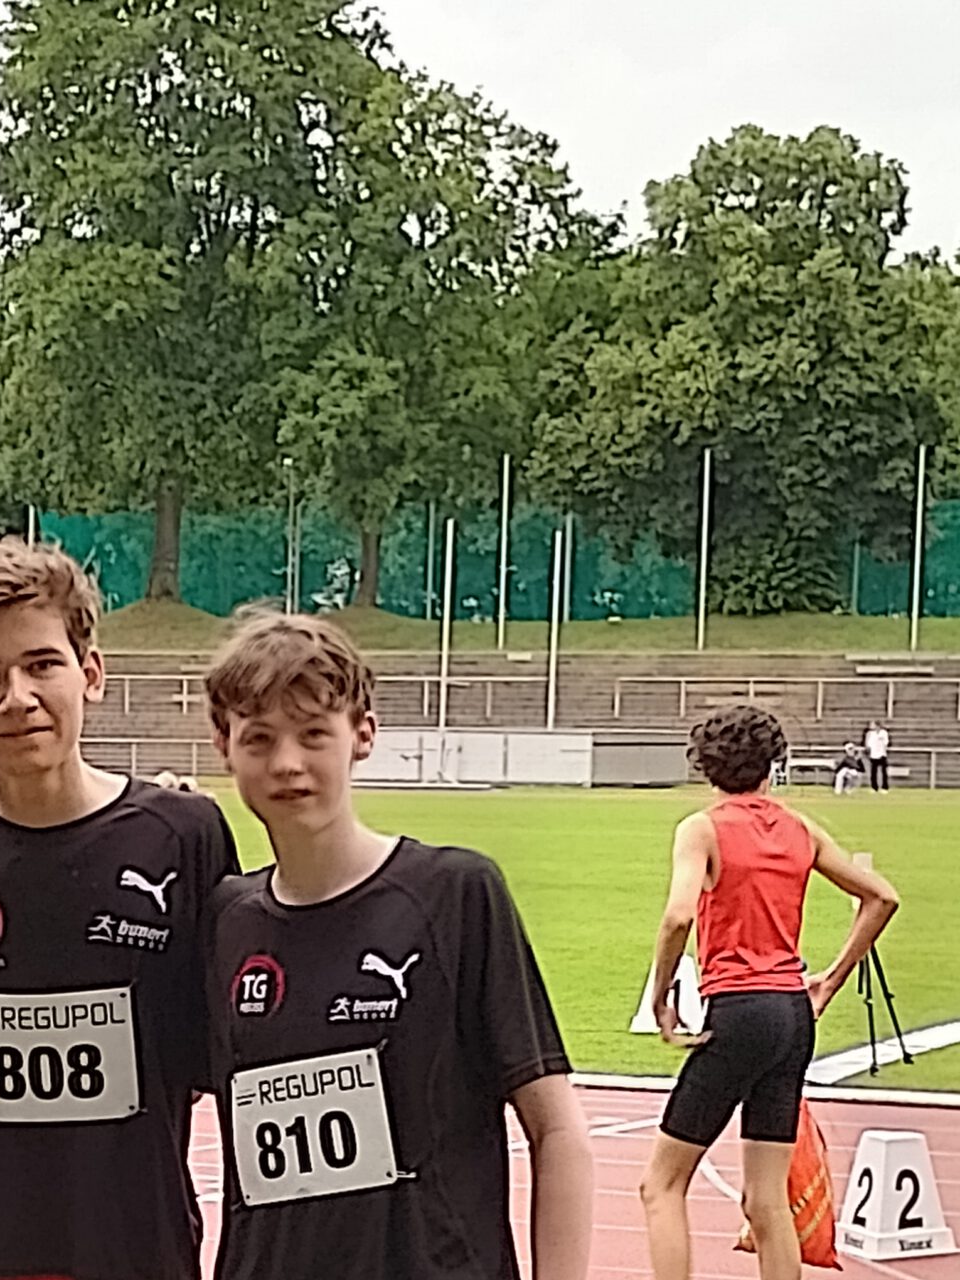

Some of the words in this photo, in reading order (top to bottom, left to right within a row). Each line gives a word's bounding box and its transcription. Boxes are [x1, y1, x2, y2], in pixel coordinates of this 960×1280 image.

[242, 973, 268, 1000] TG
[0, 1002, 126, 1030] REGUPOL
[258, 1064, 375, 1106] REGUPOL
[256, 1110, 357, 1180] 810
[852, 1167, 873, 1228] 2
[895, 1169, 923, 1230] 2
